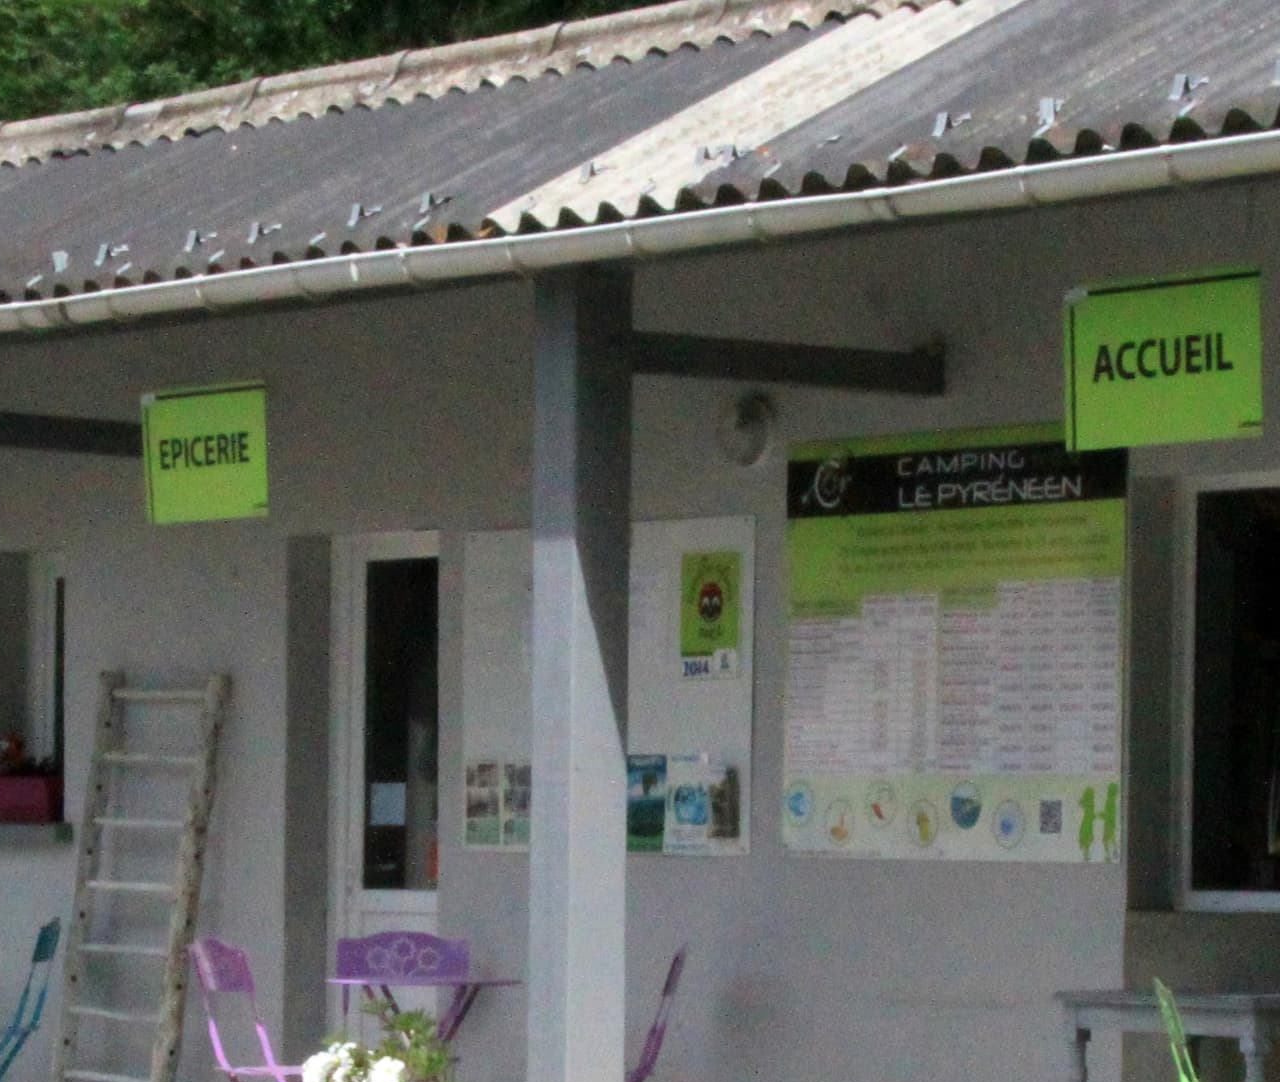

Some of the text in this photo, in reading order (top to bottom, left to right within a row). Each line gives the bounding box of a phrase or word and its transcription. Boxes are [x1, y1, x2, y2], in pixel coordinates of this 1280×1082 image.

[1092, 332, 1235, 384] ACCUEIL
[158, 431, 250, 471] EPICERIE
[897, 450, 1025, 477] CAMPING
